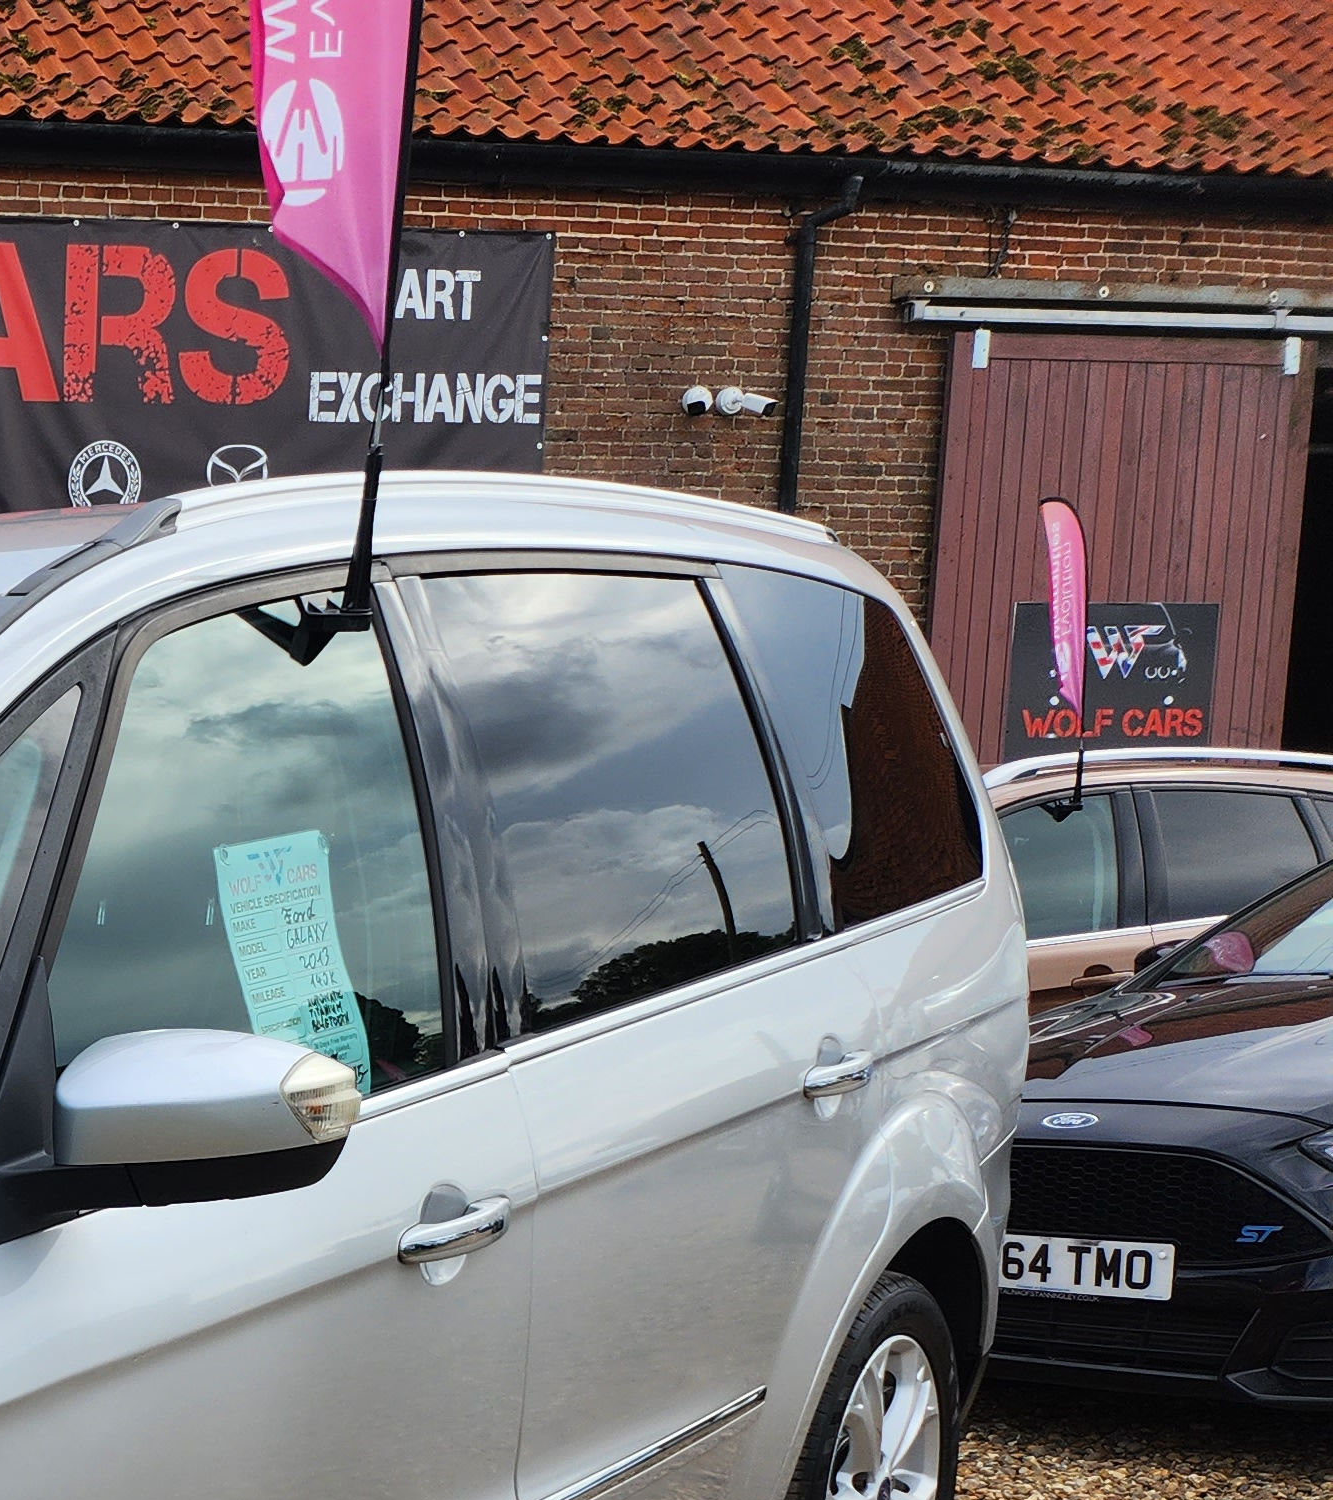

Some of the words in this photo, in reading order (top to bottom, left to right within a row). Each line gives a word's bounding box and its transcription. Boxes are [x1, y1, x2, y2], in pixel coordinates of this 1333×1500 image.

[394, 269, 482, 321] ART
[309, 371, 544, 425] EXCHANGE
[78, 443, 134, 466] MERCEDES
[1022, 708, 1115, 738] WOLF
[1121, 708, 1204, 738] CARS
[229, 874, 262, 896] WOLF
[287, 863, 318, 884] CARS
[230, 897, 263, 914] VEHICLE
[264, 885, 321, 907] SPECIFICATION
[233, 918, 257, 932] MAKE
[281, 899, 315, 925] Ford
[238, 941, 267, 956] MODEL
[287, 922, 328, 949] GALAXY
[245, 967, 267, 981] YEAR
[299, 946, 330, 969] 2013
[252, 986, 287, 1004] MILEAGE
[1235, 1225, 1284, 1243] ST
[1001, 1241, 1052, 1283] 64
[1066, 1244, 1153, 1291] TMO
